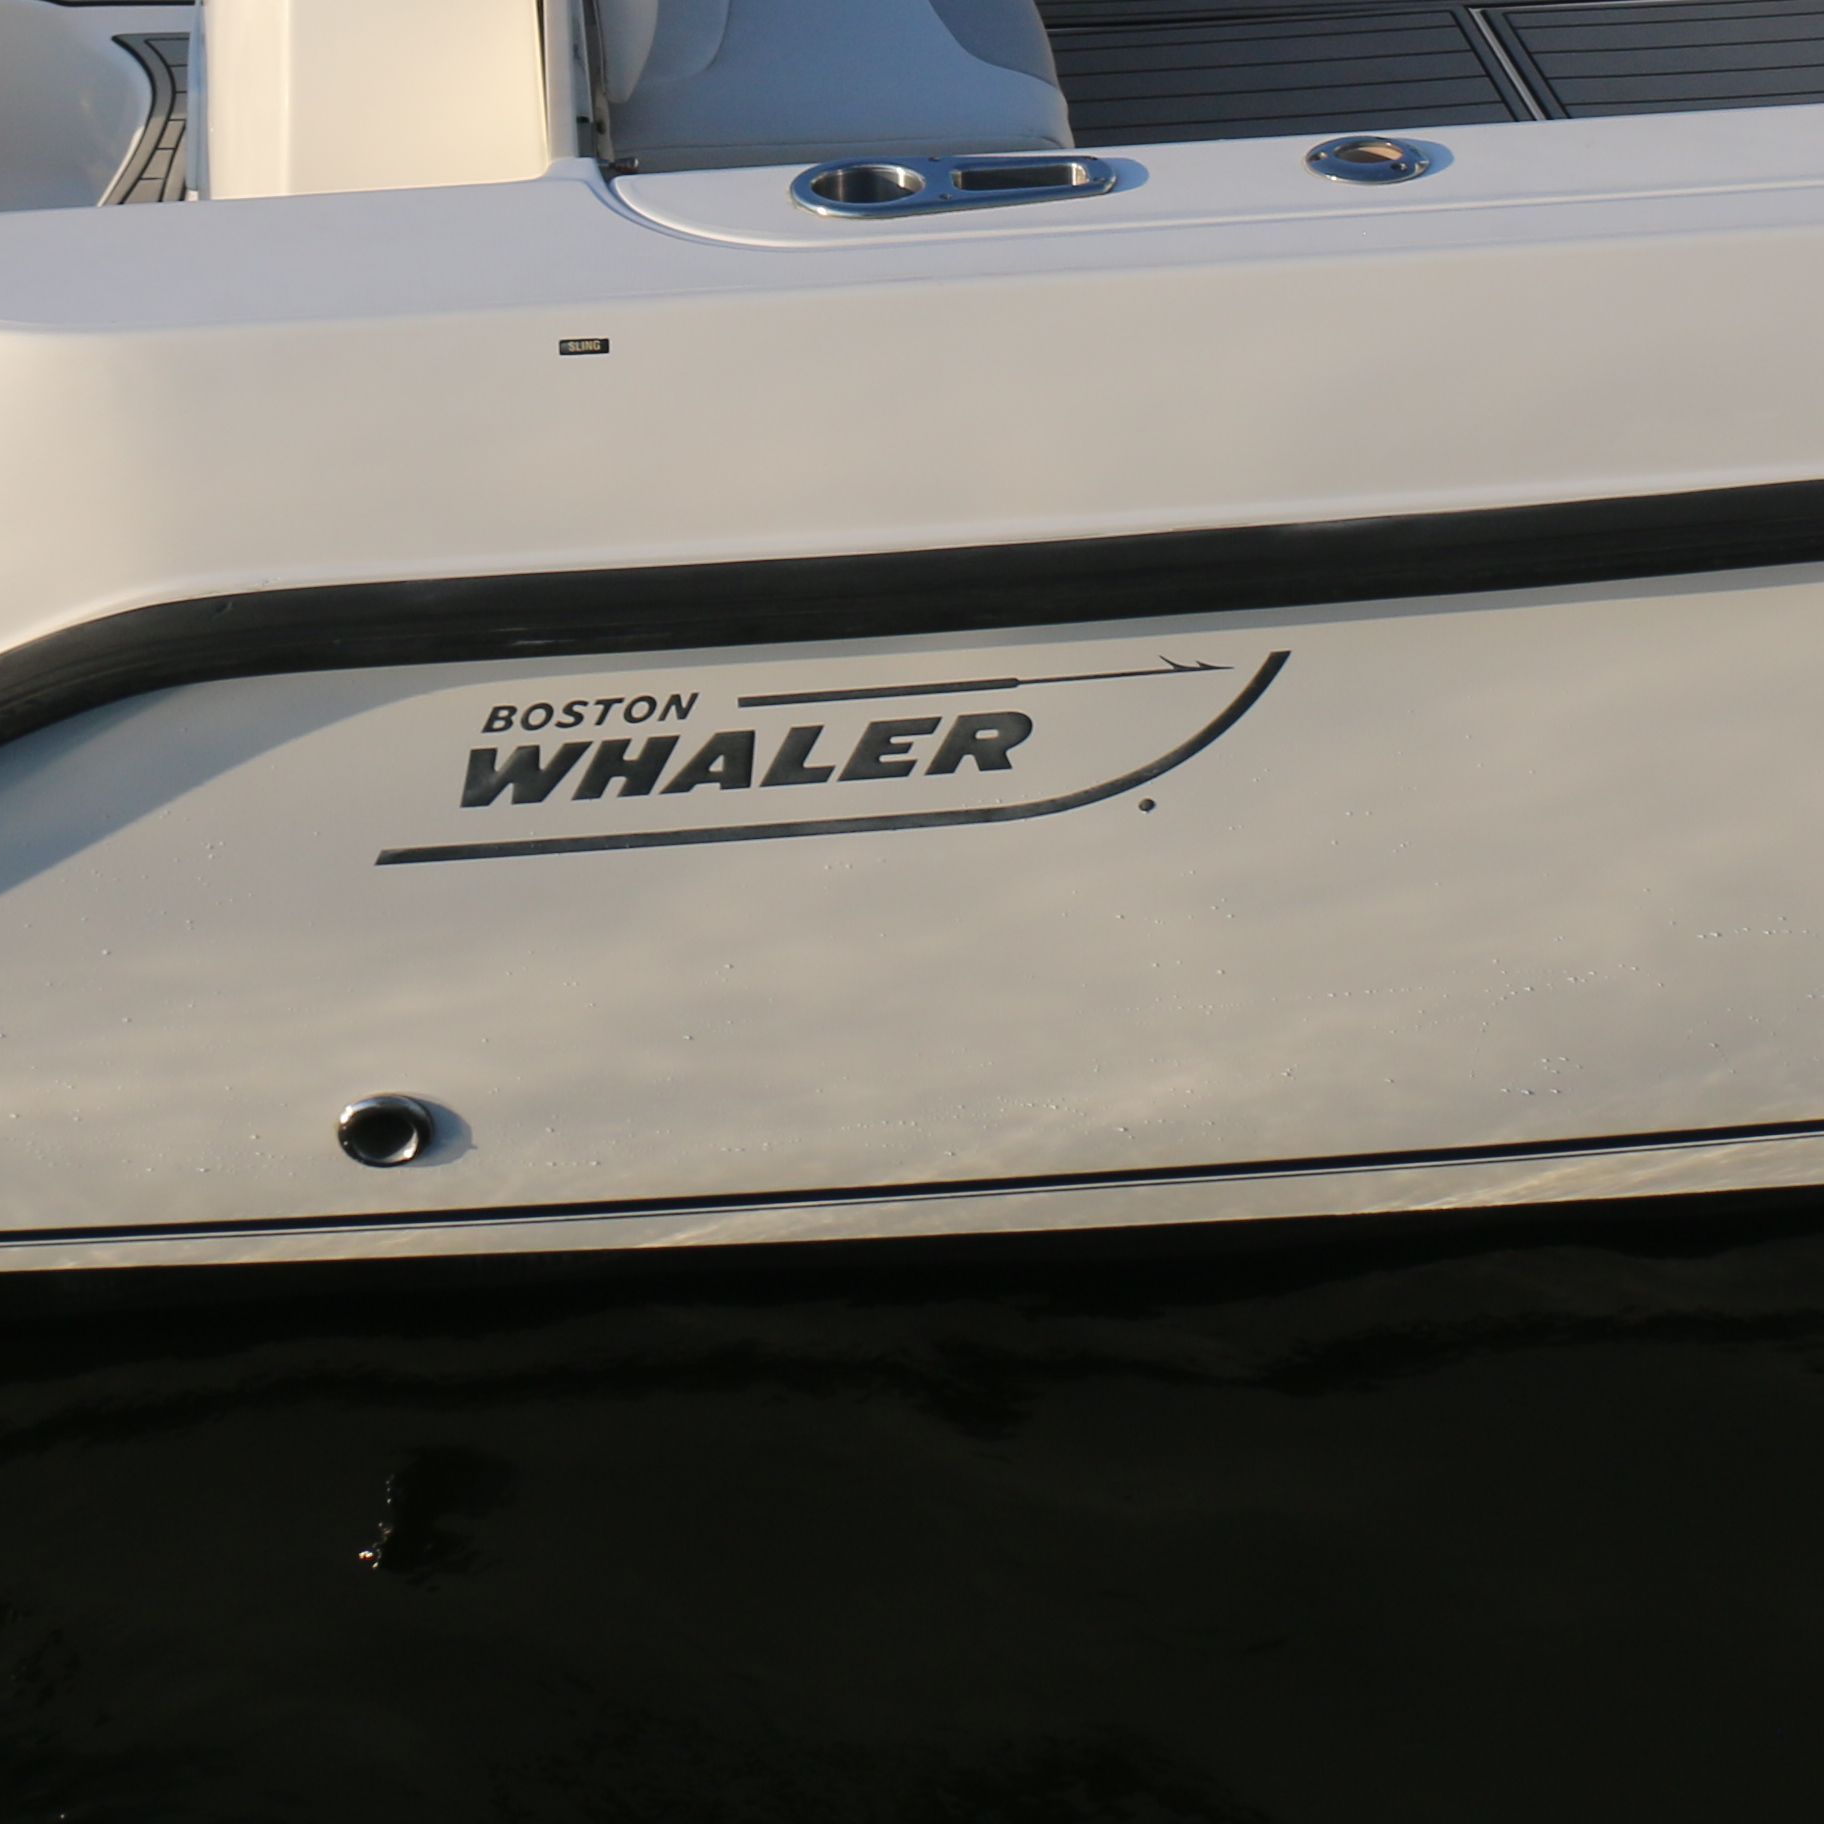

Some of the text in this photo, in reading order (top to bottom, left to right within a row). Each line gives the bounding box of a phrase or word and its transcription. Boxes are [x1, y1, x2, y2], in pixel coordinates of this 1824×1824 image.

[567, 339, 601, 352] SLING
[481, 692, 699, 733] BOSTON
[460, 710, 1033, 808] WHALER
